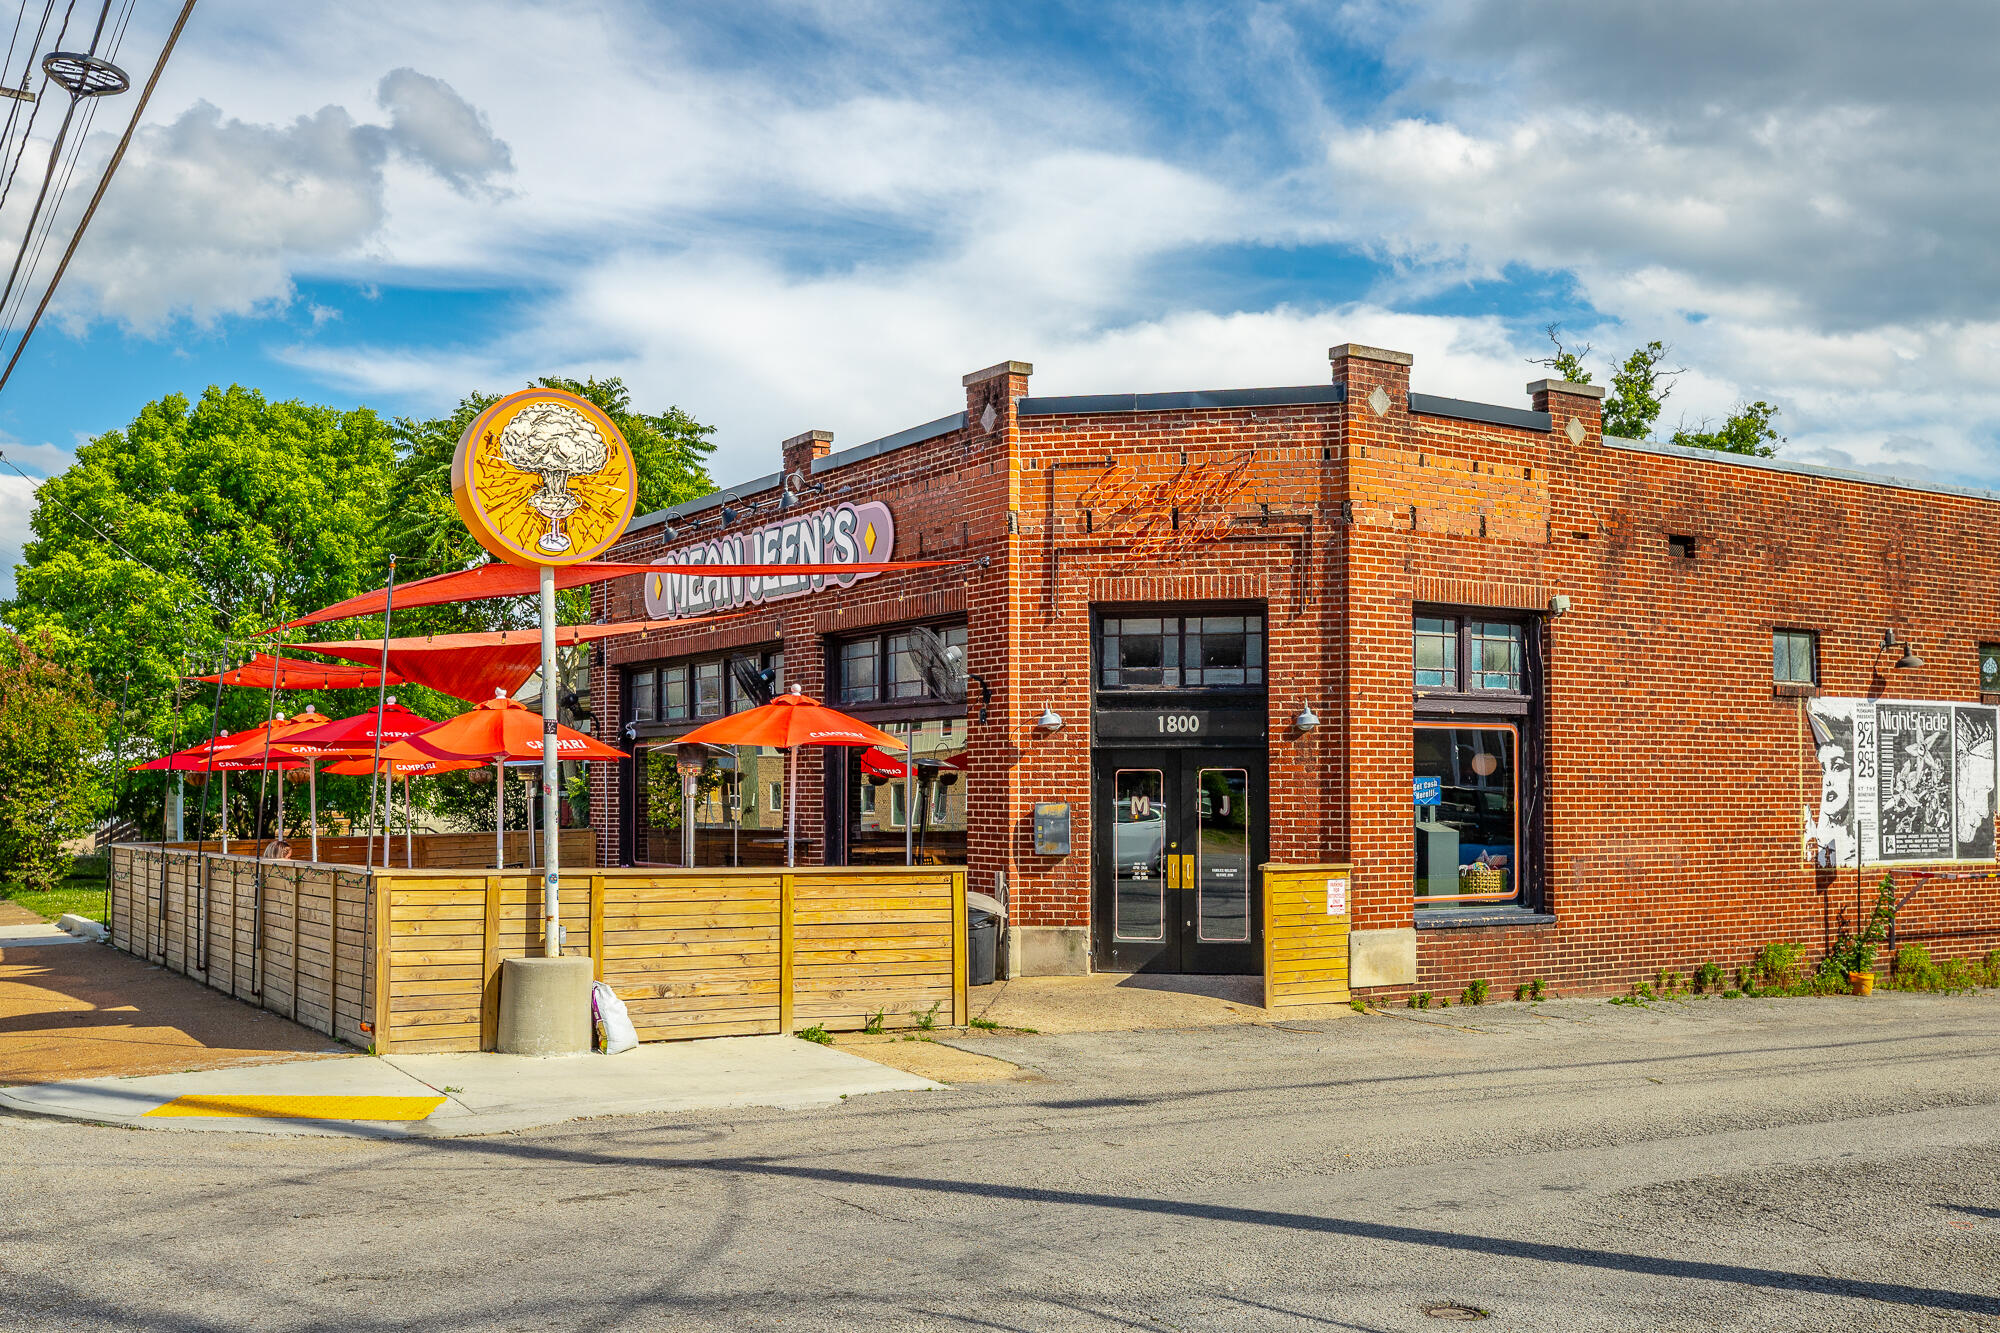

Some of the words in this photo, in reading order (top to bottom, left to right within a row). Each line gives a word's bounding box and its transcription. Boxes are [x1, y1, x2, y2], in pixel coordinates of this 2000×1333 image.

[1096, 451, 1257, 516] Cocktail
[1124, 511, 1236, 557] Dive
[667, 534, 744, 617] MEAN
[749, 508, 860, 602] JEEN'S
[1158, 715, 1200, 733] 1800
[1857, 721, 1874, 731] OCT
[1880, 711, 1948, 734] NightShade
[526, 739, 588, 750] CAPARI
[1858, 731, 1874, 748] 24
[1857, 751, 1874, 761] OCT
[395, 762, 436, 772] CAMPARI
[1858, 760, 1875, 778] 25
[1130, 795, 1150, 816] M
[1219, 795, 1231, 816] J
